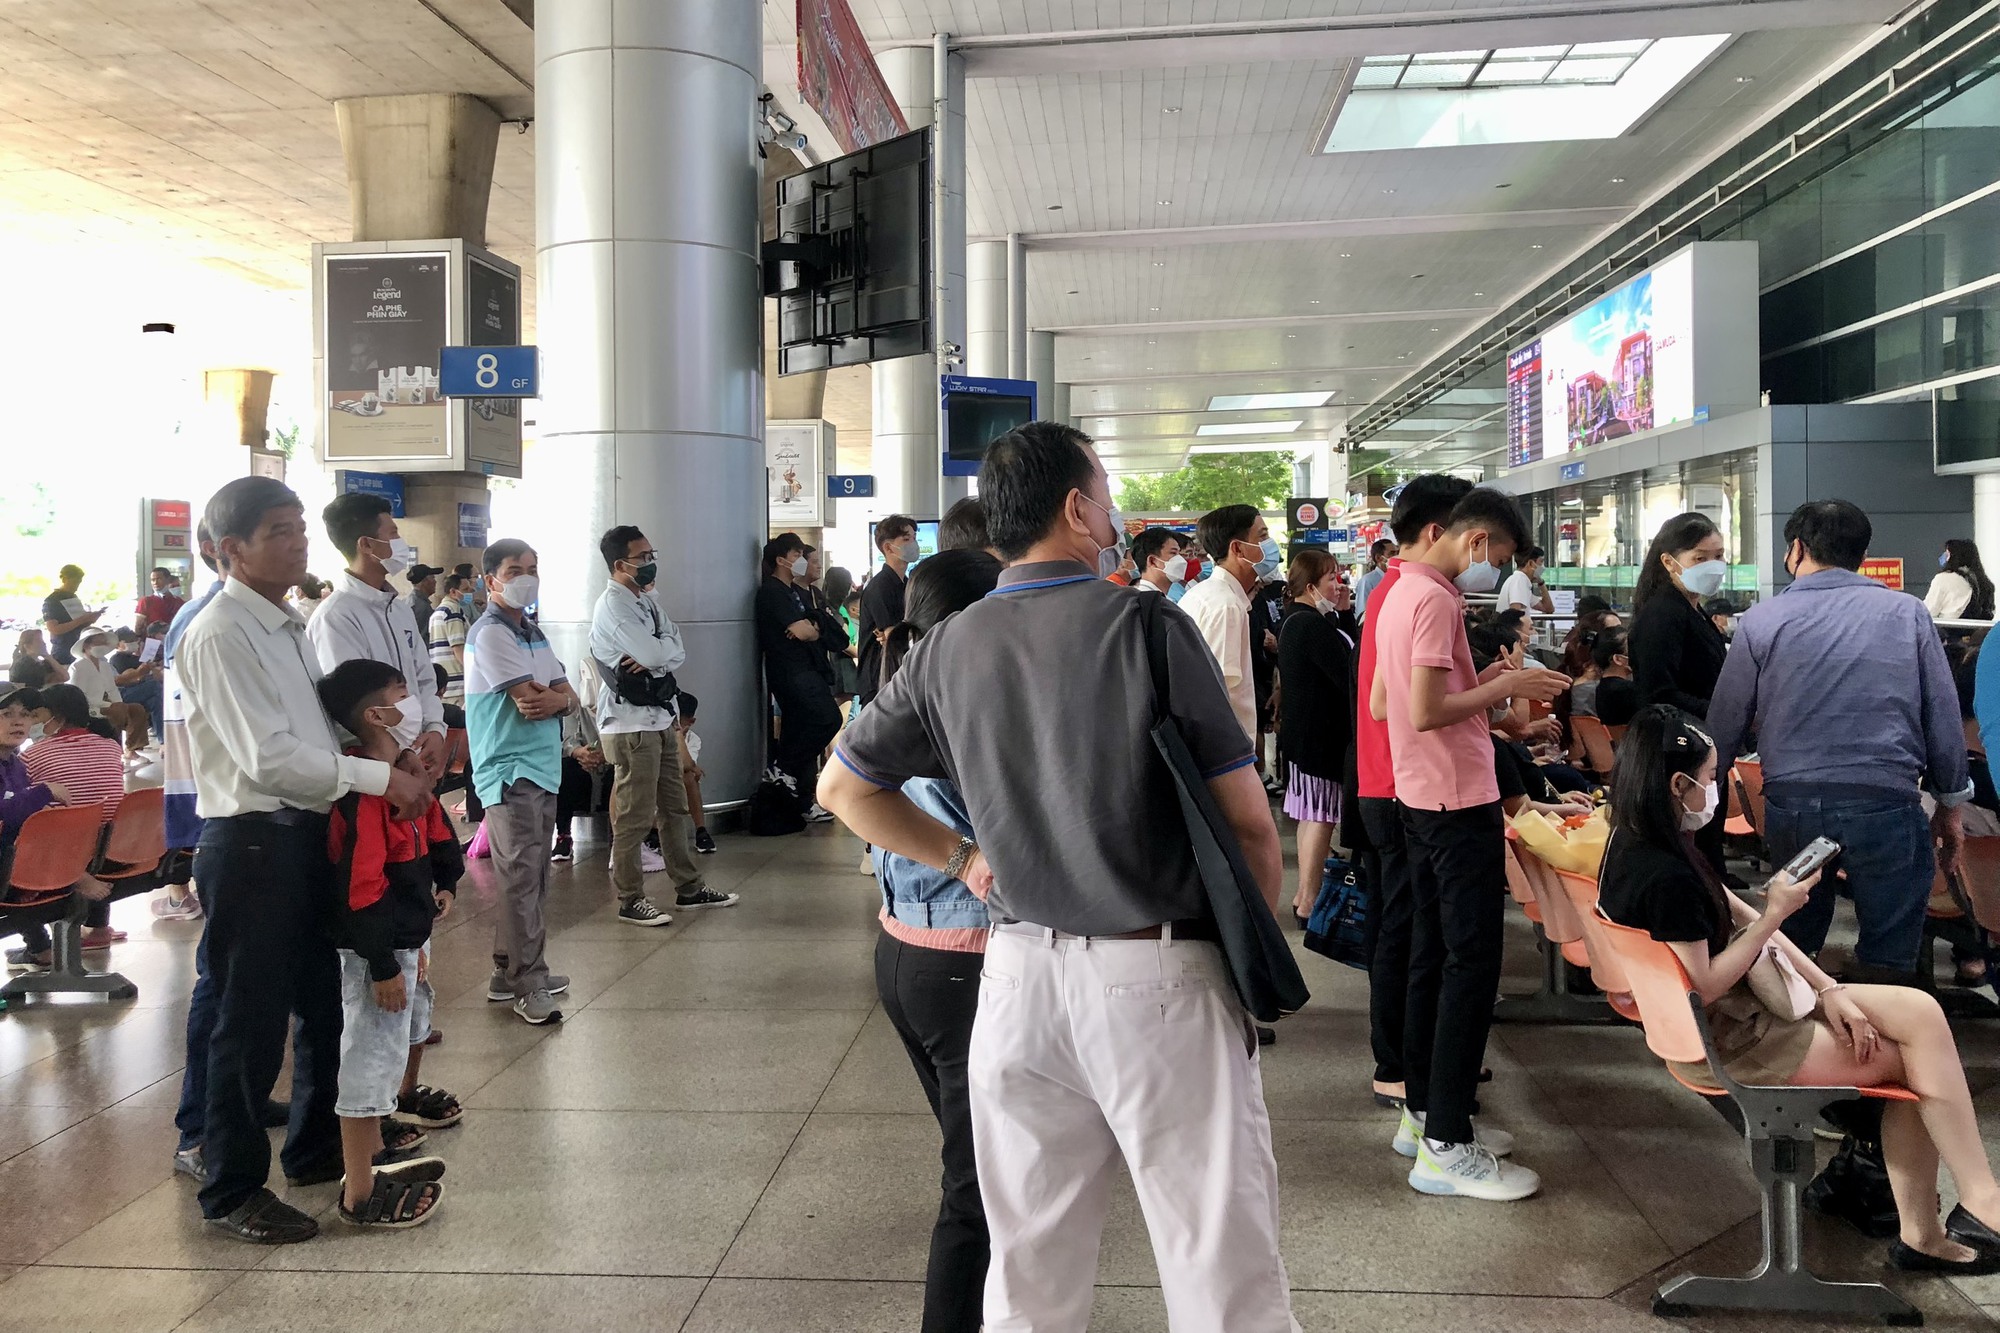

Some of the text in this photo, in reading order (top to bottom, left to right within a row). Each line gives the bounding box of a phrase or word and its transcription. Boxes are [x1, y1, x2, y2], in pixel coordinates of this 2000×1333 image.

[475, 353, 529, 389] 8 GF
[844, 478, 855, 494] 9
